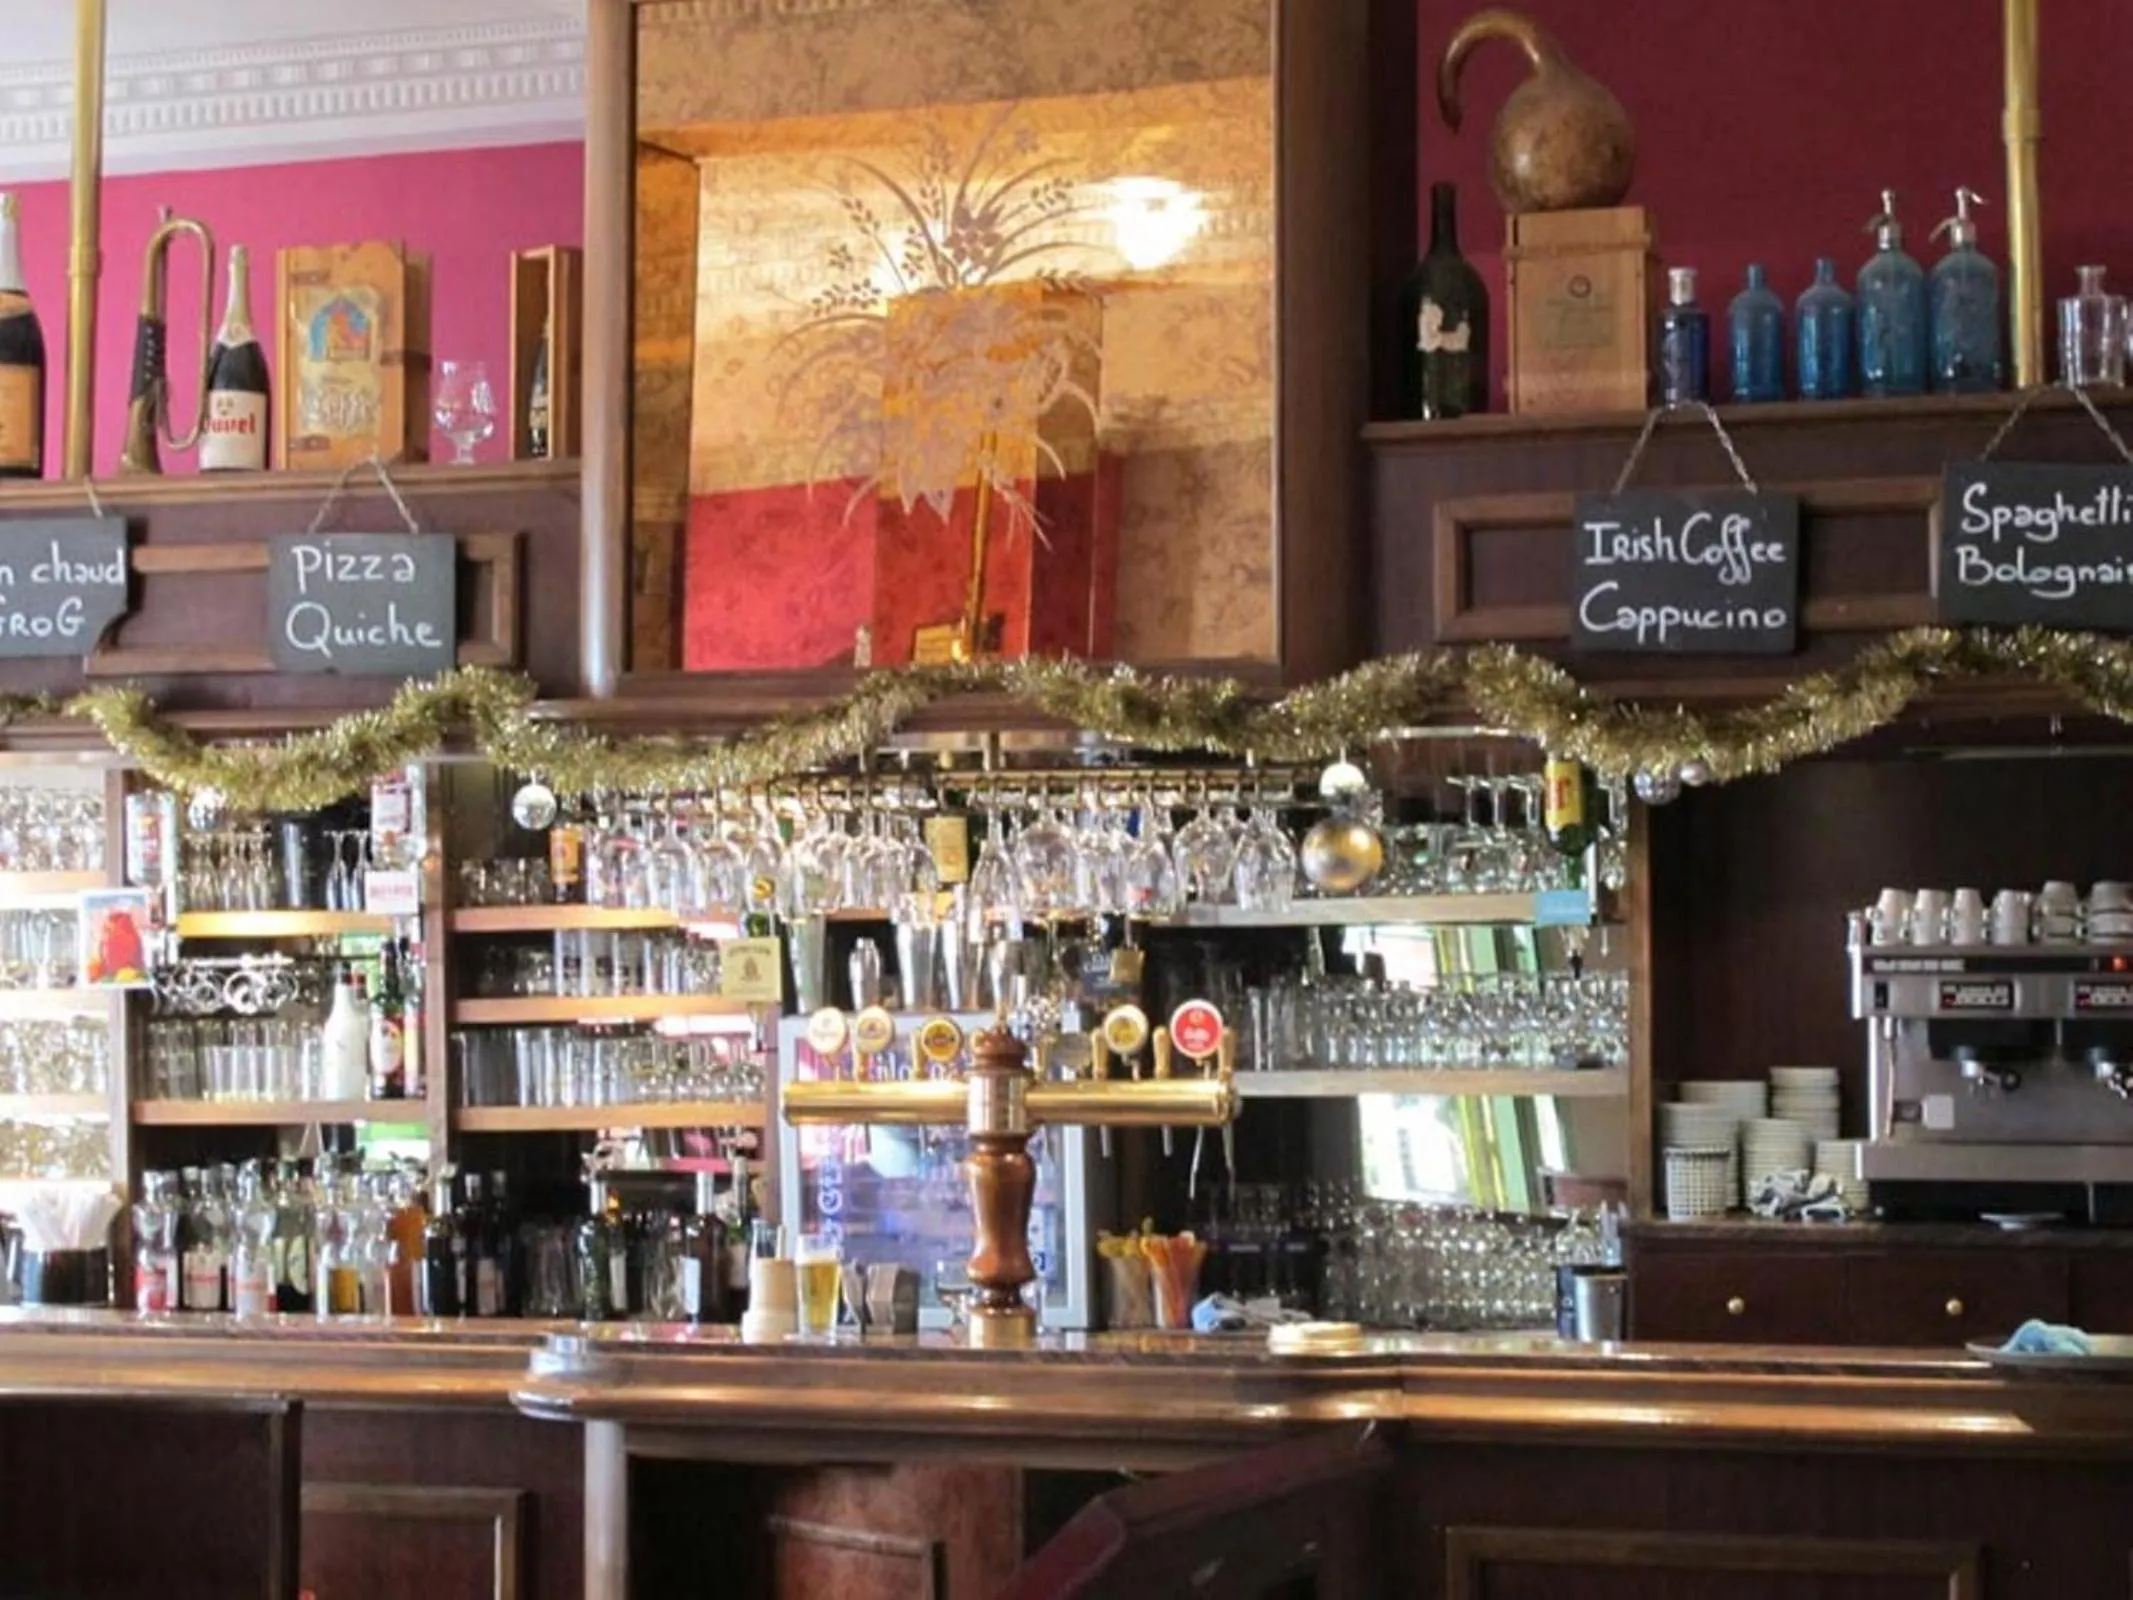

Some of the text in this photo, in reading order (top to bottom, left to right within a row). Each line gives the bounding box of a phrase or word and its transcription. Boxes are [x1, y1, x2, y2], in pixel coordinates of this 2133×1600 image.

[30, 540, 125, 585] chaud
[291, 540, 415, 594] Pizza
[1584, 511, 1786, 585] Irish Coffee
[285, 601, 442, 658] Quiche
[1580, 581, 1786, 643] Cappucino
